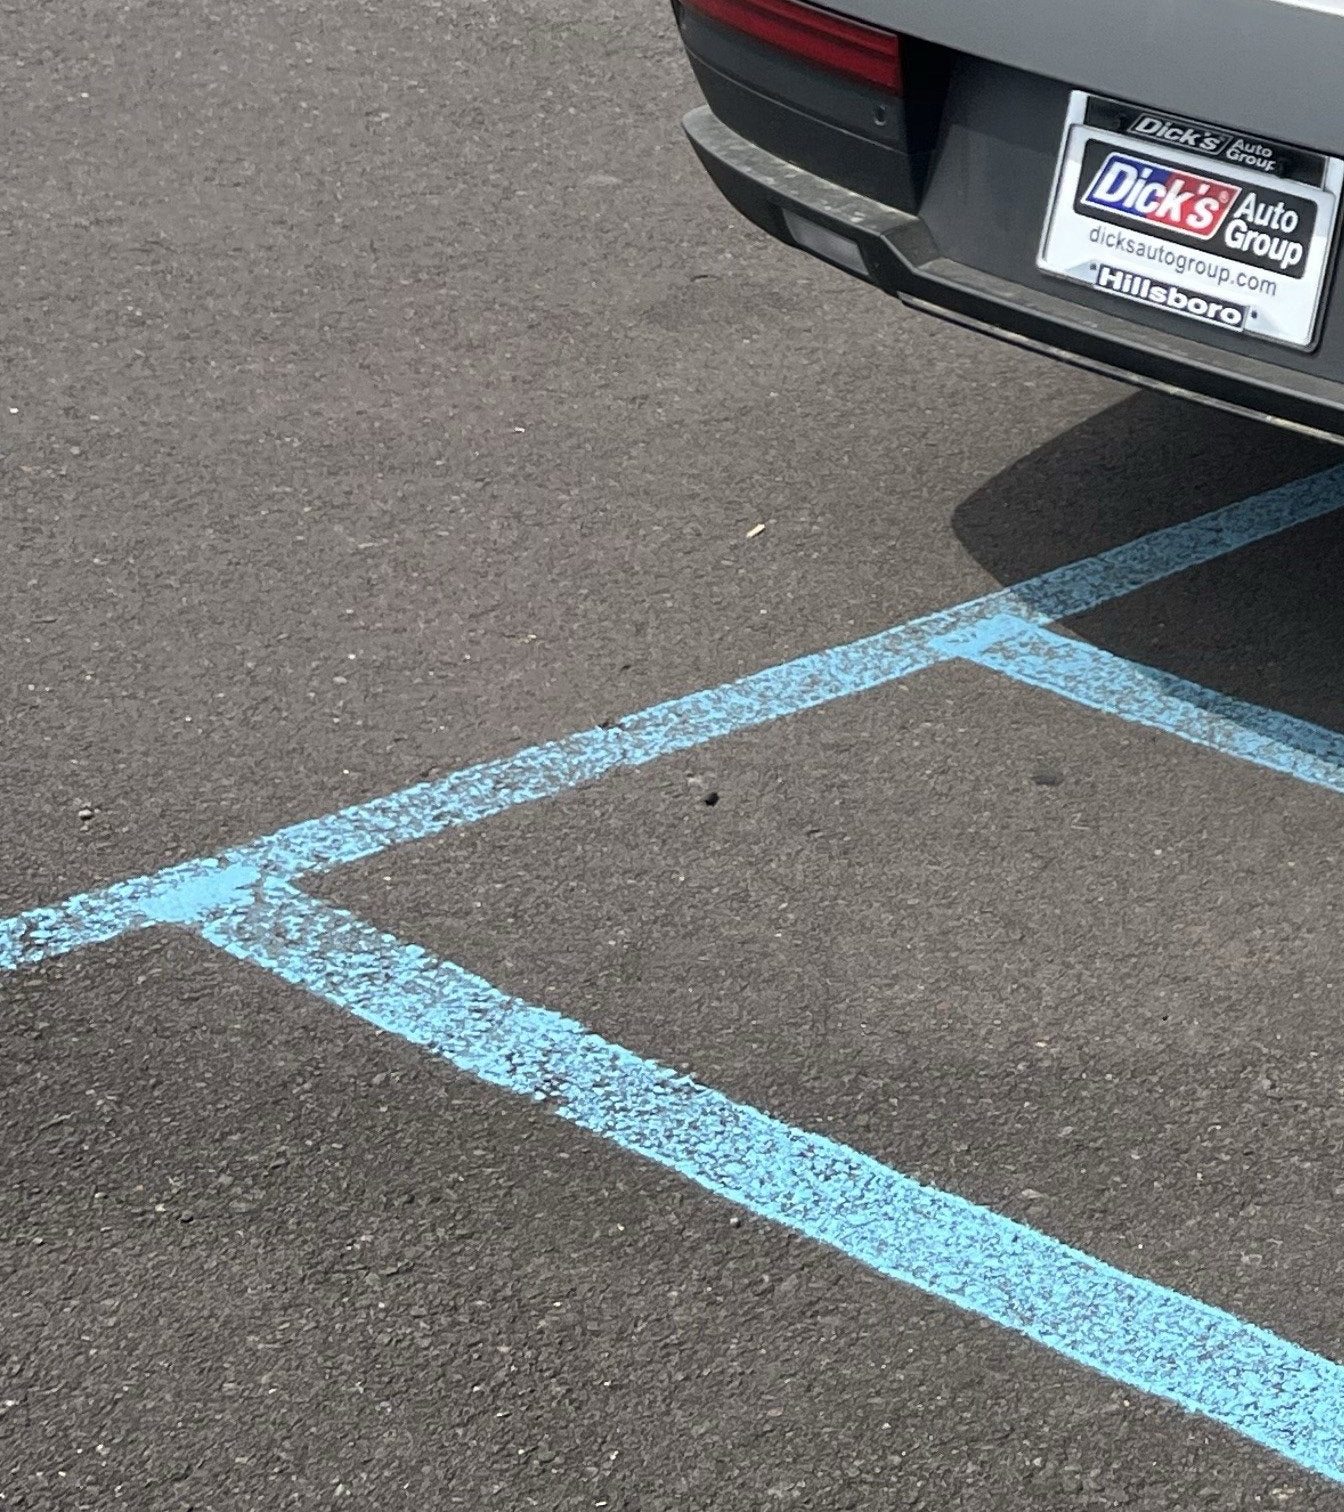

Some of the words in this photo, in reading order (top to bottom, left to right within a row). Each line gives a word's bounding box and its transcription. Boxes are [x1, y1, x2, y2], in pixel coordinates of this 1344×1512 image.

[1134, 116, 1222, 152] Dick's
[1231, 138, 1274, 159] Auto
[1094, 161, 1222, 231] Dick's
[1233, 192, 1299, 234] Auto
[1089, 225, 1278, 297] dicksautogroup.com
[1224, 219, 1304, 270] Group
[1098, 265, 1243, 327] Hillsboro
